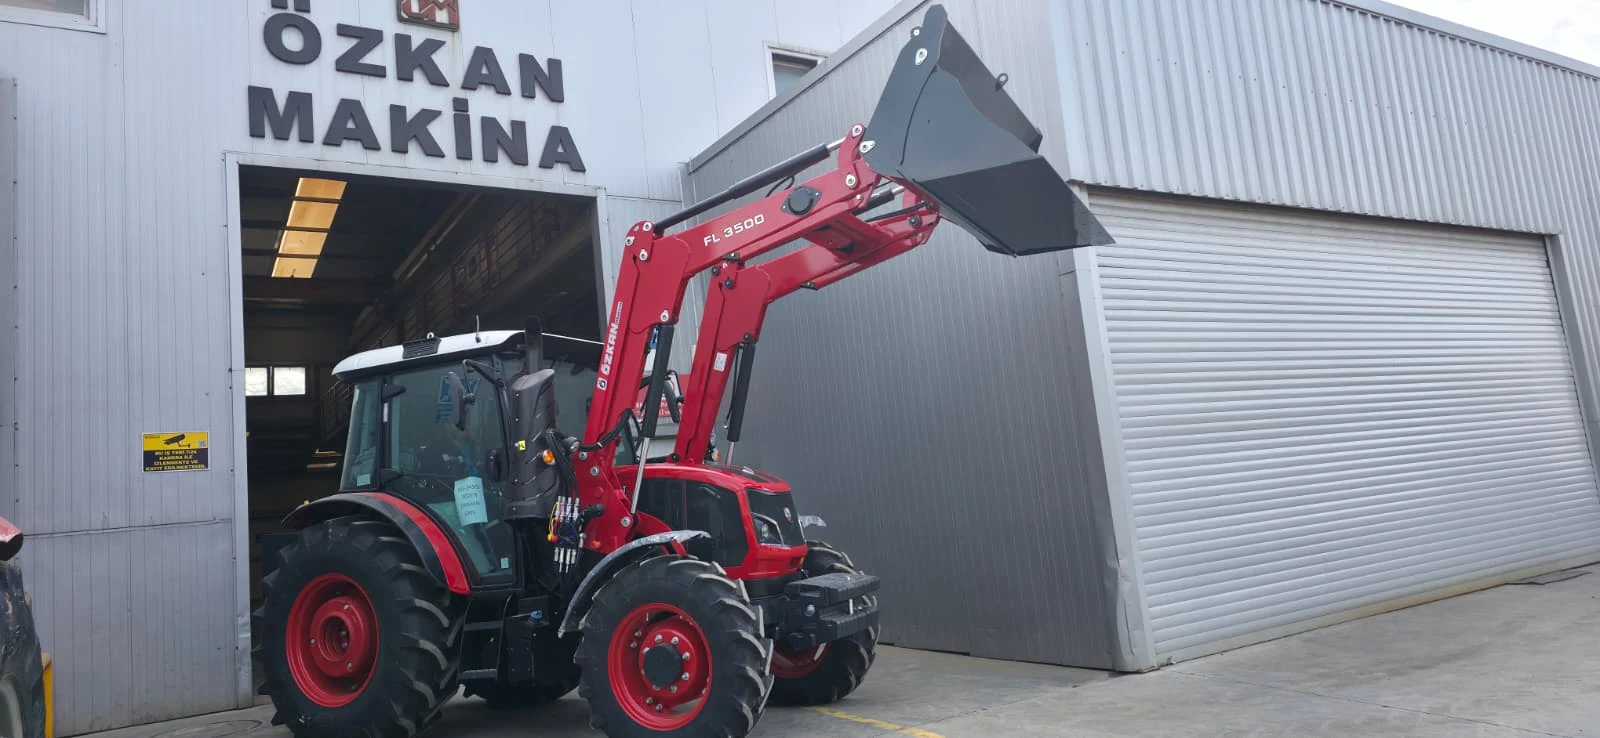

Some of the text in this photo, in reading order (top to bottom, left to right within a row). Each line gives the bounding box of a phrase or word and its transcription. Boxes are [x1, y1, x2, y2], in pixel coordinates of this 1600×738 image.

[263, 0, 564, 103] ÖZKAN
[248, 85, 586, 173] MAKİNA
[703, 213, 765, 247] FL 3500
